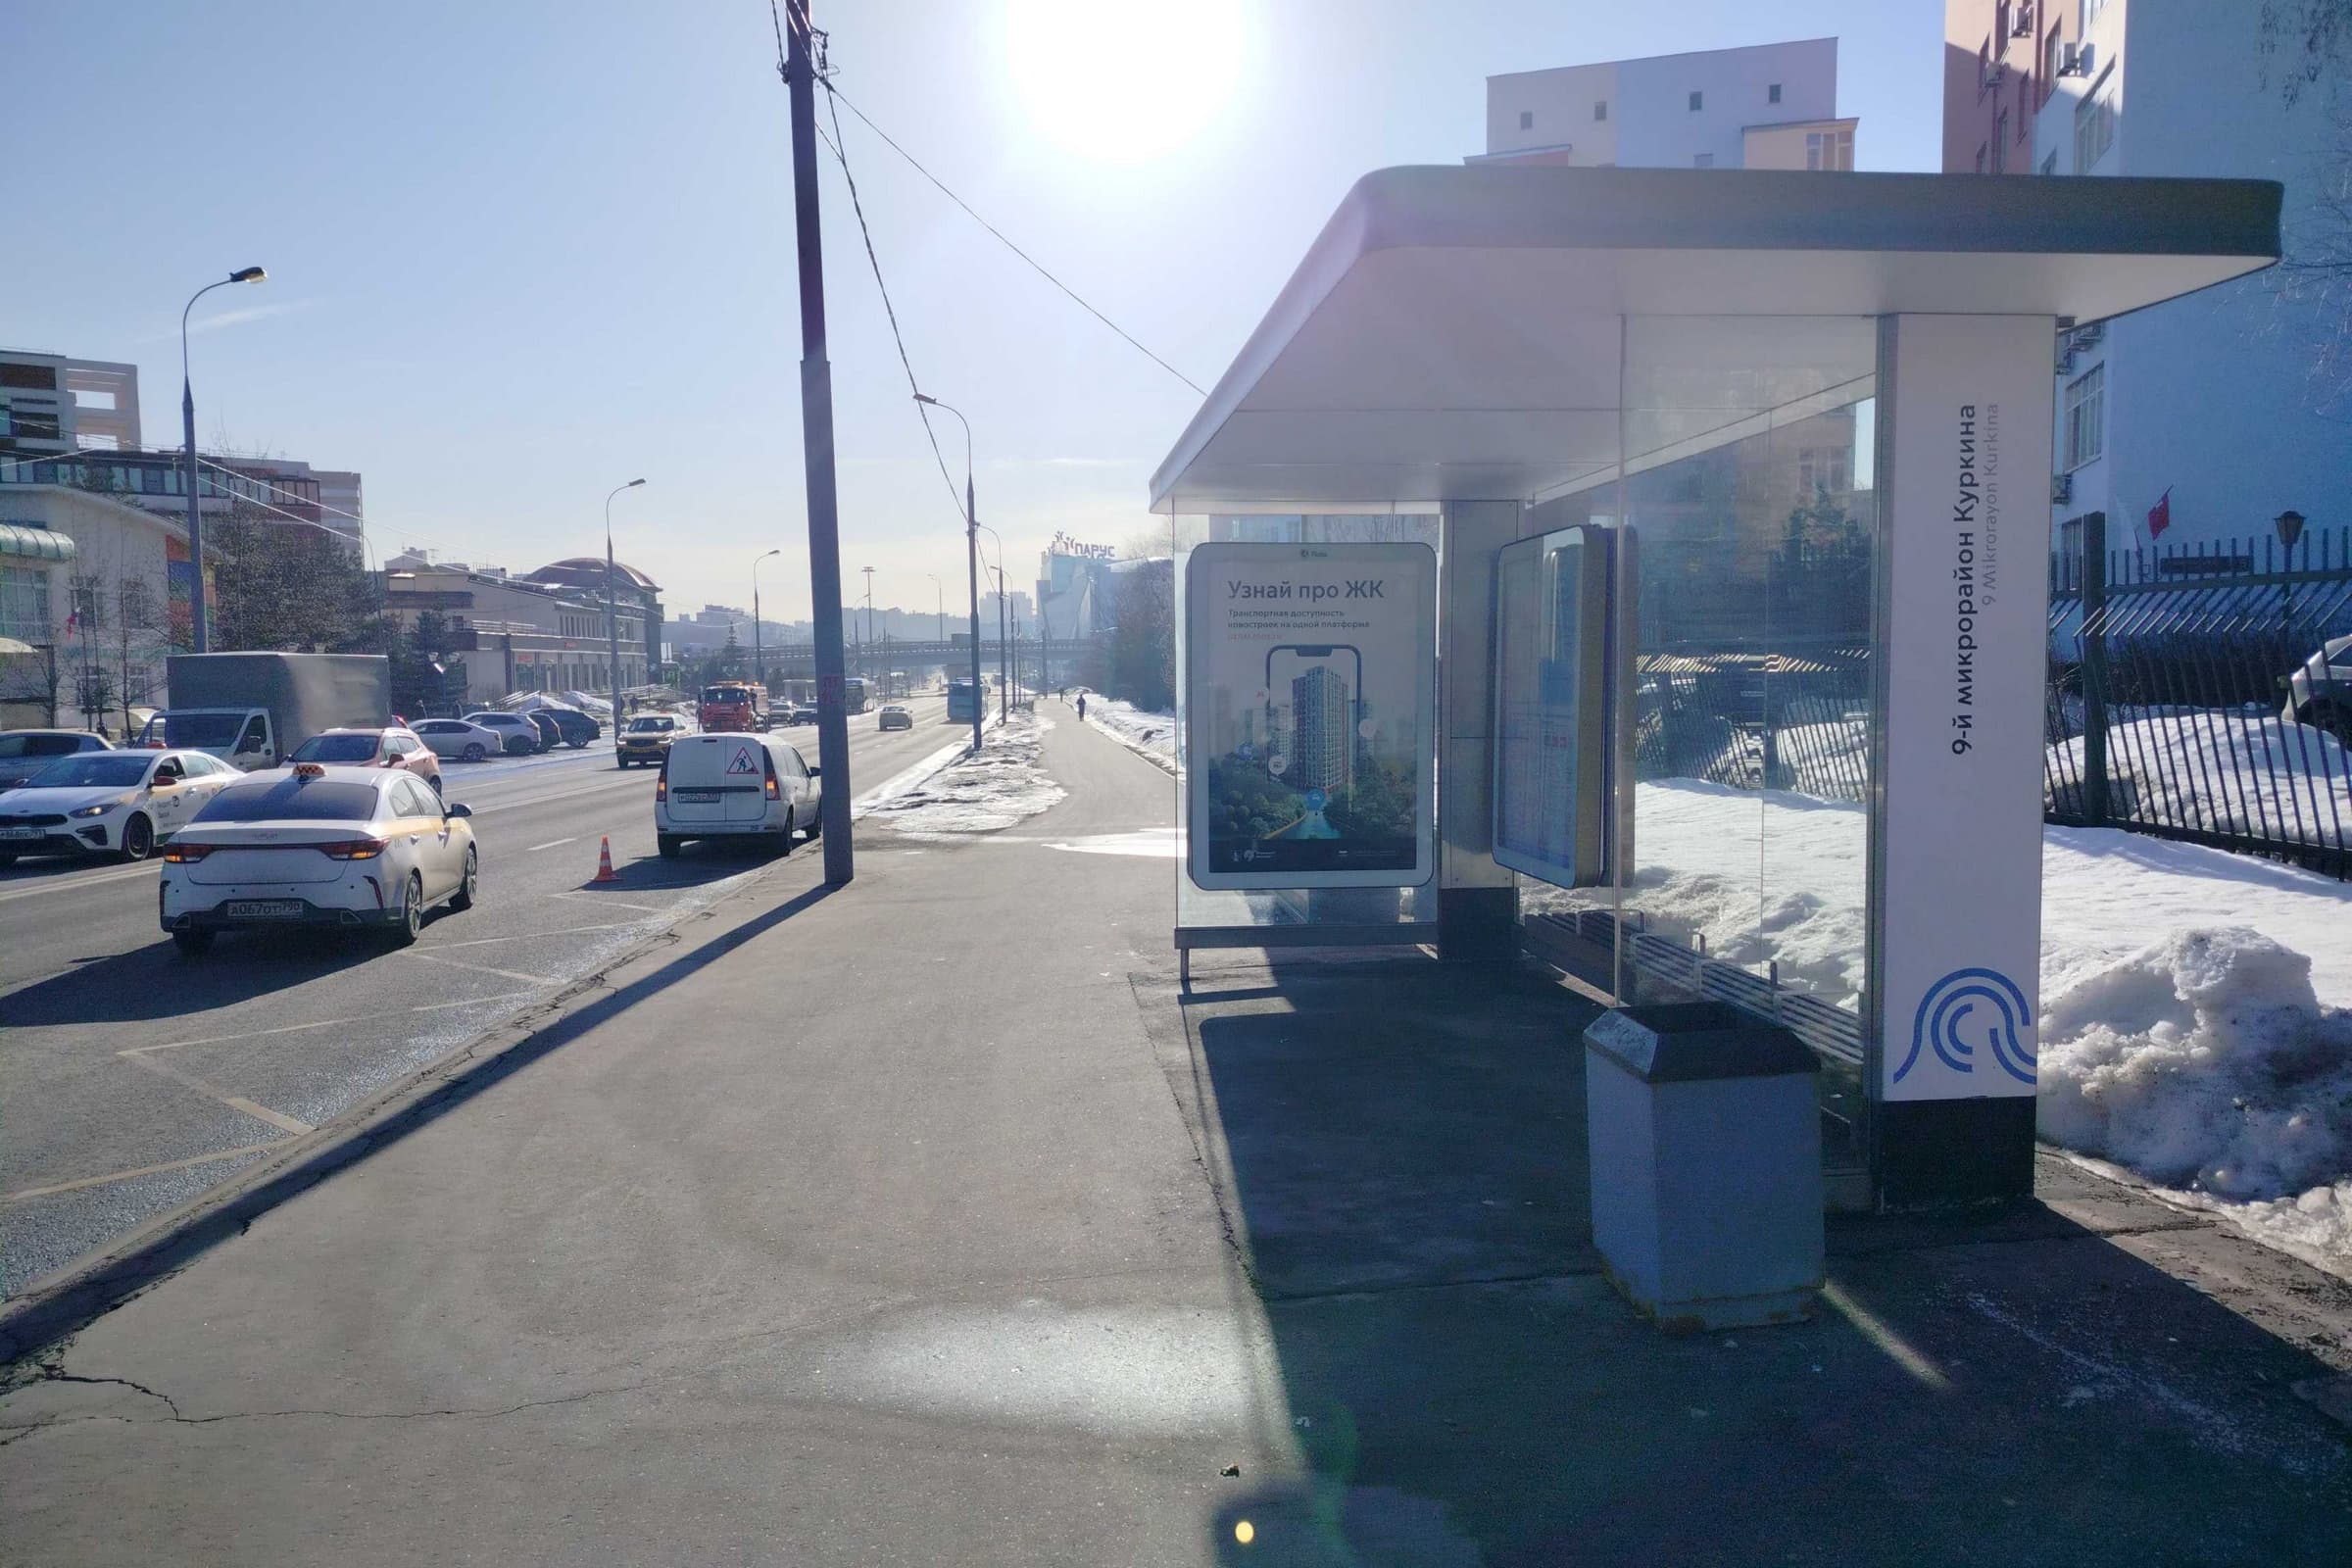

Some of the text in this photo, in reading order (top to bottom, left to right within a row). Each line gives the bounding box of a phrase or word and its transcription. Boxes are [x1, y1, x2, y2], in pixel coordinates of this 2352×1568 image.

[1981, 404, 2000, 606] 9 Mikrorayon Kurkina
[1074, 543, 1115, 559] ПАРУС
[1227, 579, 1385, 603] Узнай про ЖК
[1951, 405, 1979, 756] 9-й микрорайон Куркина
[1227, 609, 1346, 619] Транспортная доступность
